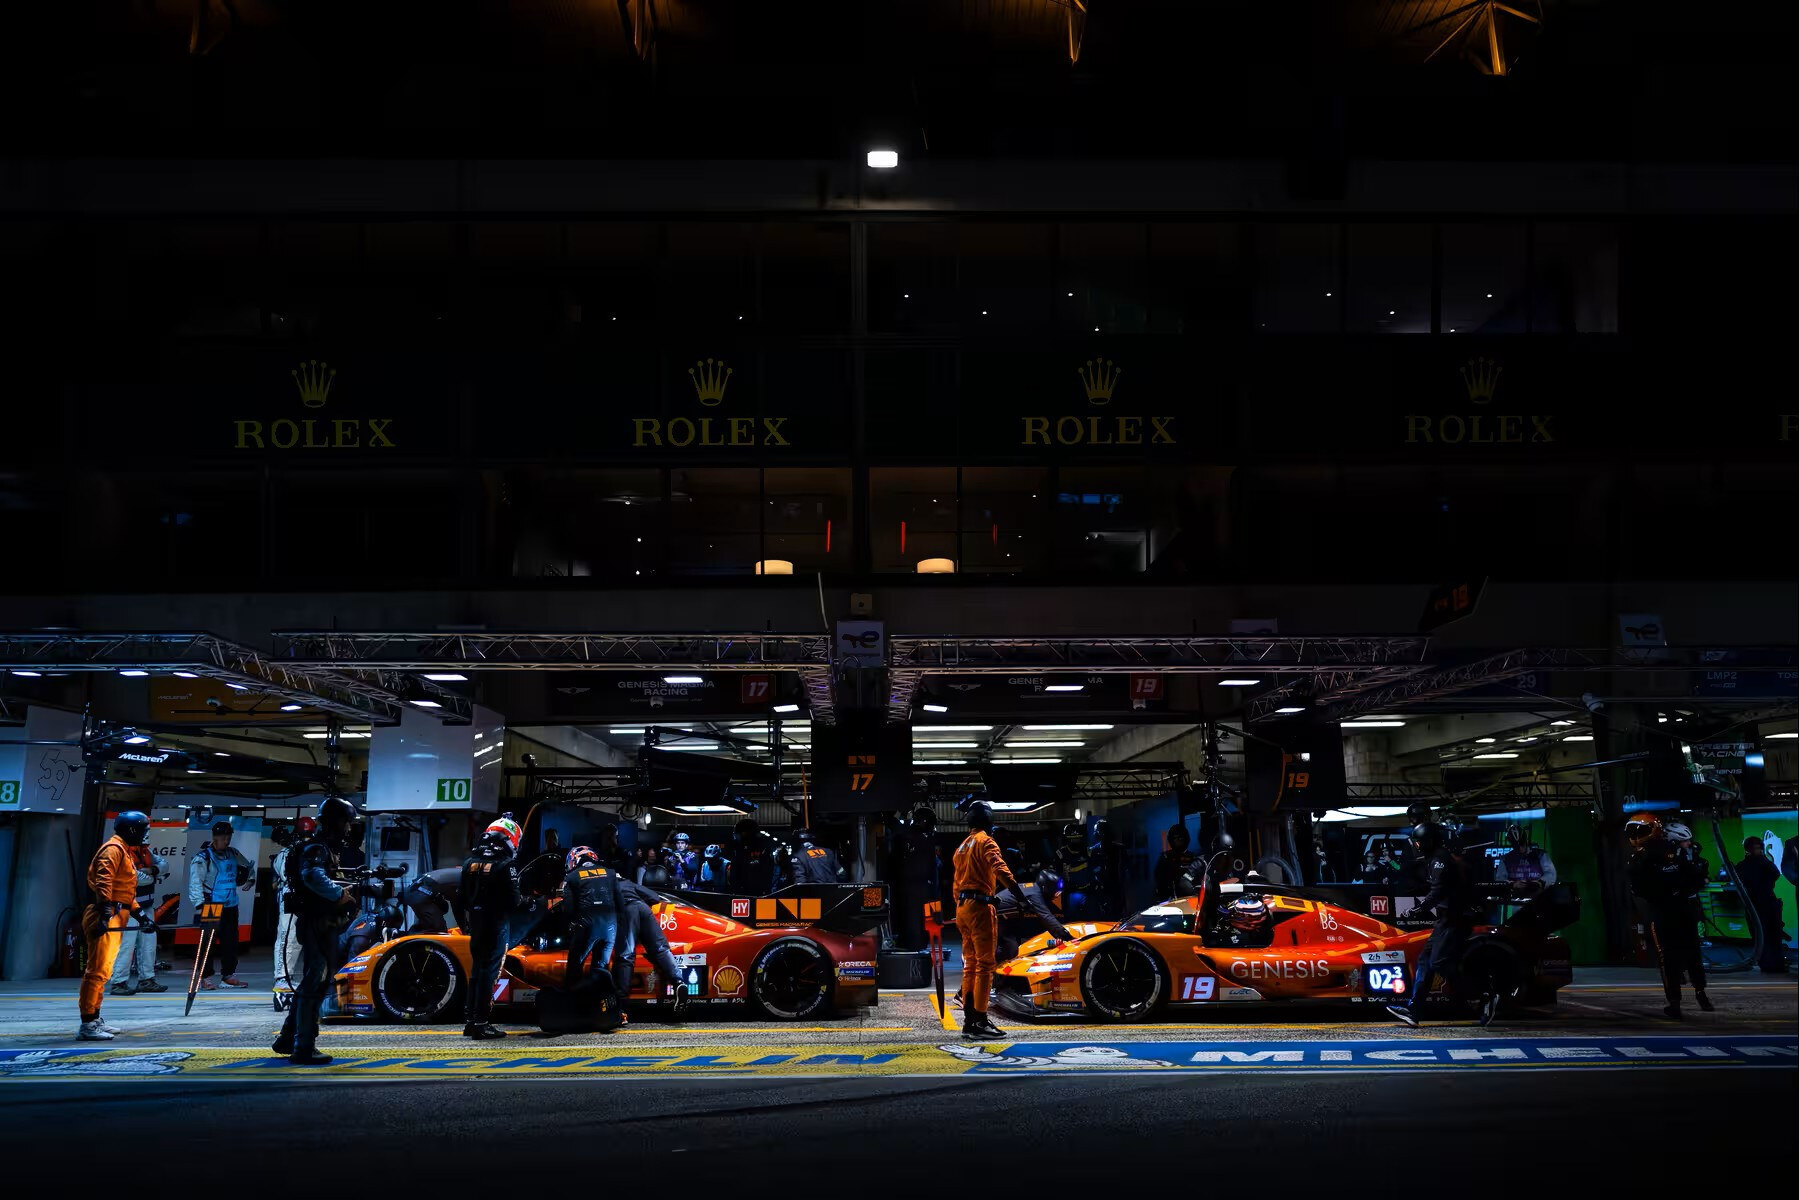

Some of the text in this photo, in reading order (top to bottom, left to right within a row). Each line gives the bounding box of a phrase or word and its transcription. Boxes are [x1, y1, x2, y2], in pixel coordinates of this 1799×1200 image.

[233, 418, 396, 449] ROLEX
[632, 416, 791, 447] ROLEX
[1021, 416, 1177, 445] ROLEX
[1404, 415, 1555, 444] ROLEX
[617, 681, 667, 689] GENESIS
[1706, 672, 1737, 680] LMP2
[643, 687, 689, 696] RACING
[748, 681, 769, 697] 17
[1135, 678, 1157, 693] 19
[118, 752, 164, 763] McLaren
[850, 773, 875, 792] 17
[1288, 772, 1310, 788] 19
[0, 782, 15, 802] 8
[441, 779, 467, 801] 10
[152, 846, 177, 856] AGE
[732, 902, 747, 913] HY
[1372, 899, 1387, 912] HY
[1230, 959, 1330, 979] GENESIS
[493, 978, 510, 1001] 7
[1182, 976, 1215, 1000] 19
[212, 1052, 904, 1069] MICHELIN
[1189, 1044, 1799, 1063] MICHELIN
